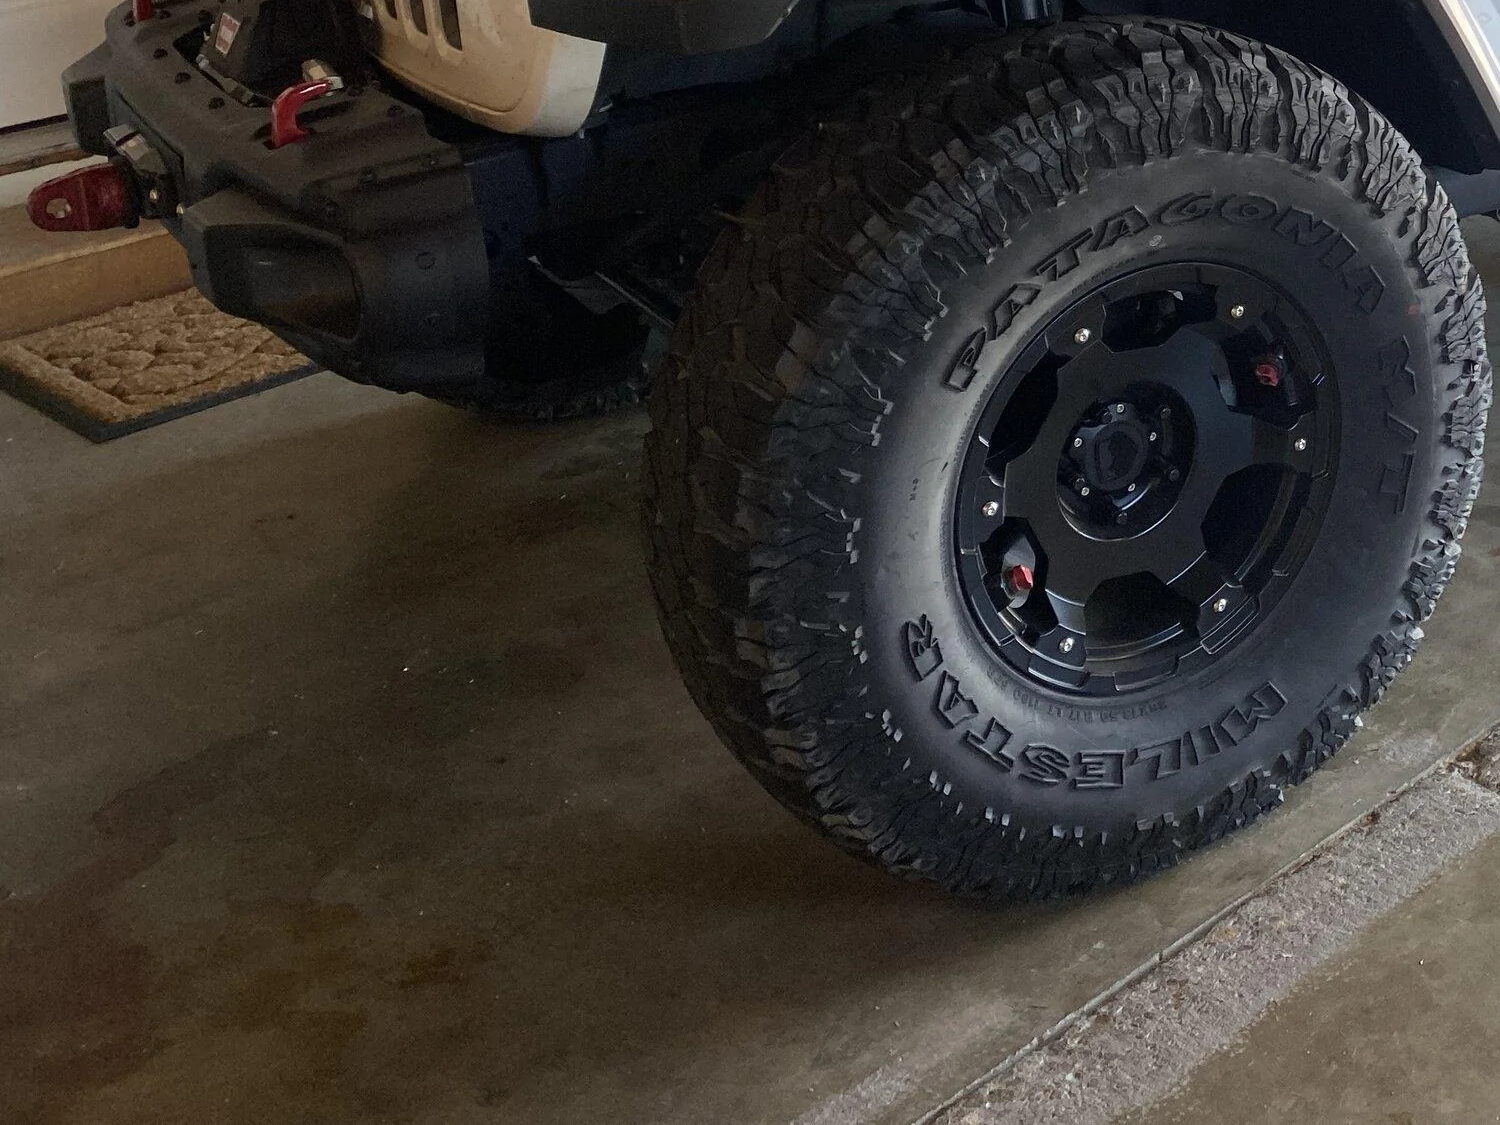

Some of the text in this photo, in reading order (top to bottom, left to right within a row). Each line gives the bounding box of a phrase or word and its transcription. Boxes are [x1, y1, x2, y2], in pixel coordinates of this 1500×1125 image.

[941, 191, 1421, 515] PATAGONIA M/T
[901, 613, 1289, 790] MILESTAR
